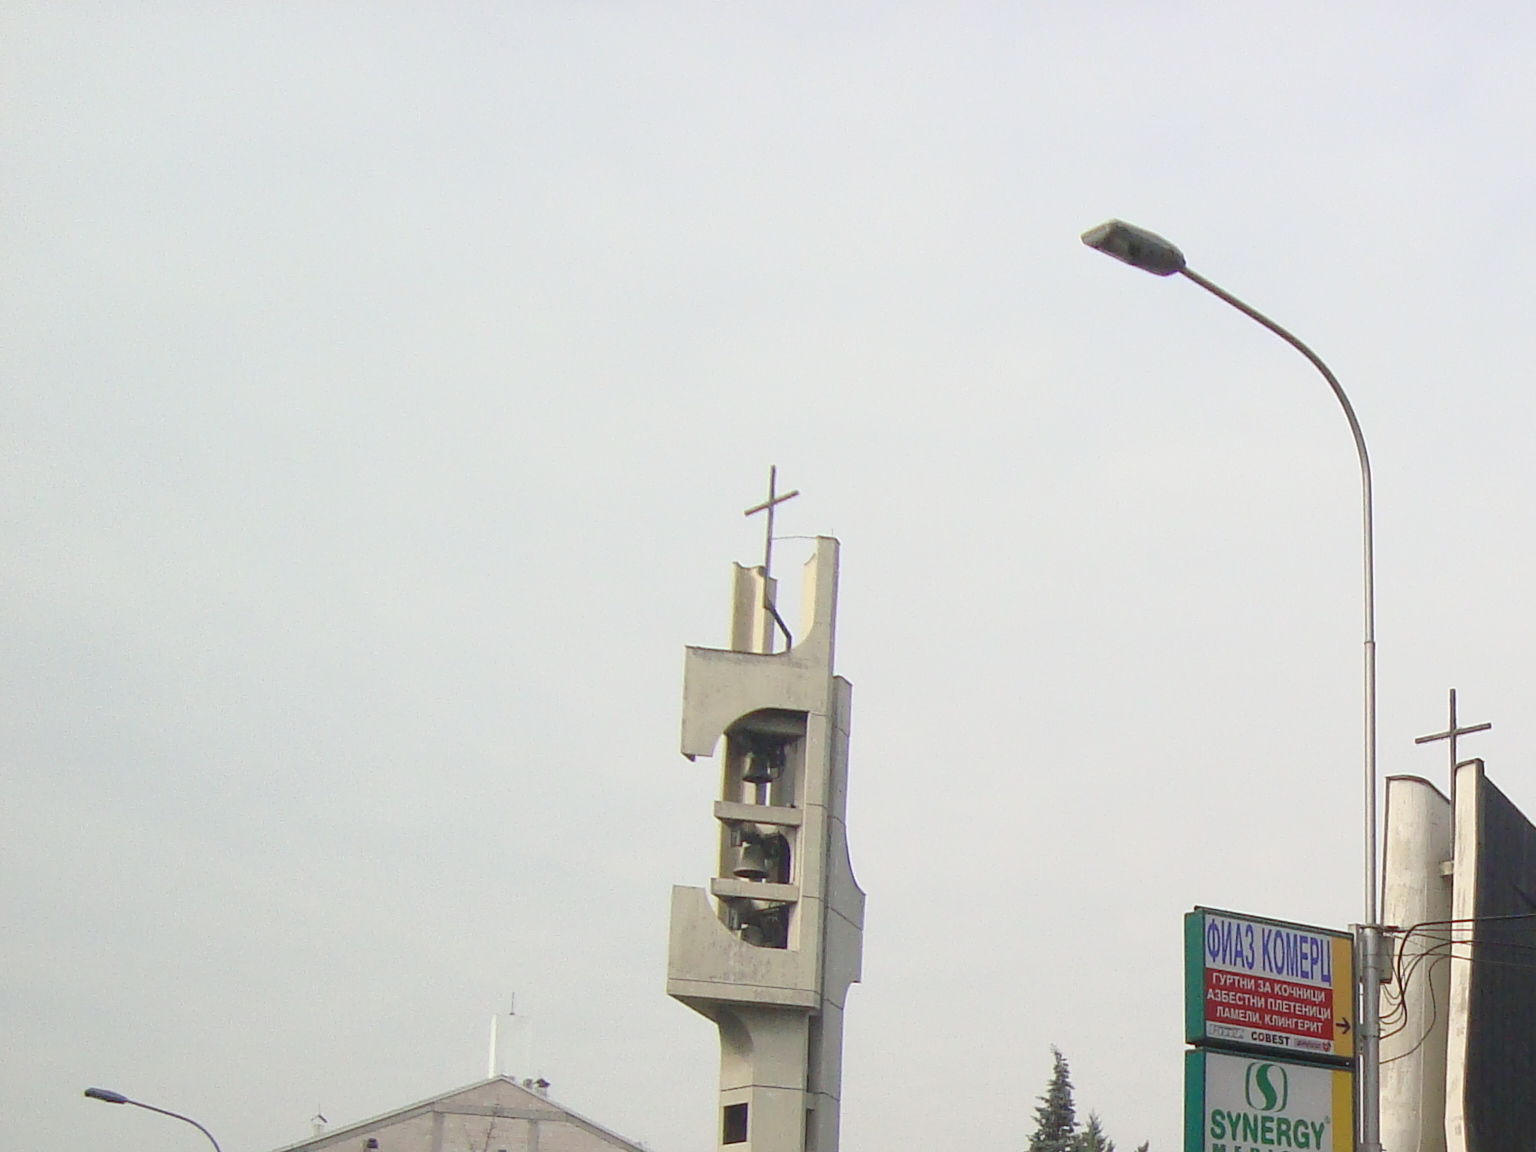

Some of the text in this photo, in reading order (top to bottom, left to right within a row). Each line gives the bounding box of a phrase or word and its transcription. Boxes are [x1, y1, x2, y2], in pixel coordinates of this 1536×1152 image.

[1207, 918, 1332, 987] ФИАЗ КОМЕРЦ
[1212, 972, 1326, 1004] ГУРТНИ ЗА КОЧНИЦИ
[1207, 988, 1331, 1021] АЗБЕСТНИ ПЛЕТЕНИЦИ
[1251, 1031, 1290, 1046] COBEST
[1264, 1013, 1323, 1033] КЛИНГЕРИТ
[1210, 1108, 1325, 1150] SYNERGY
